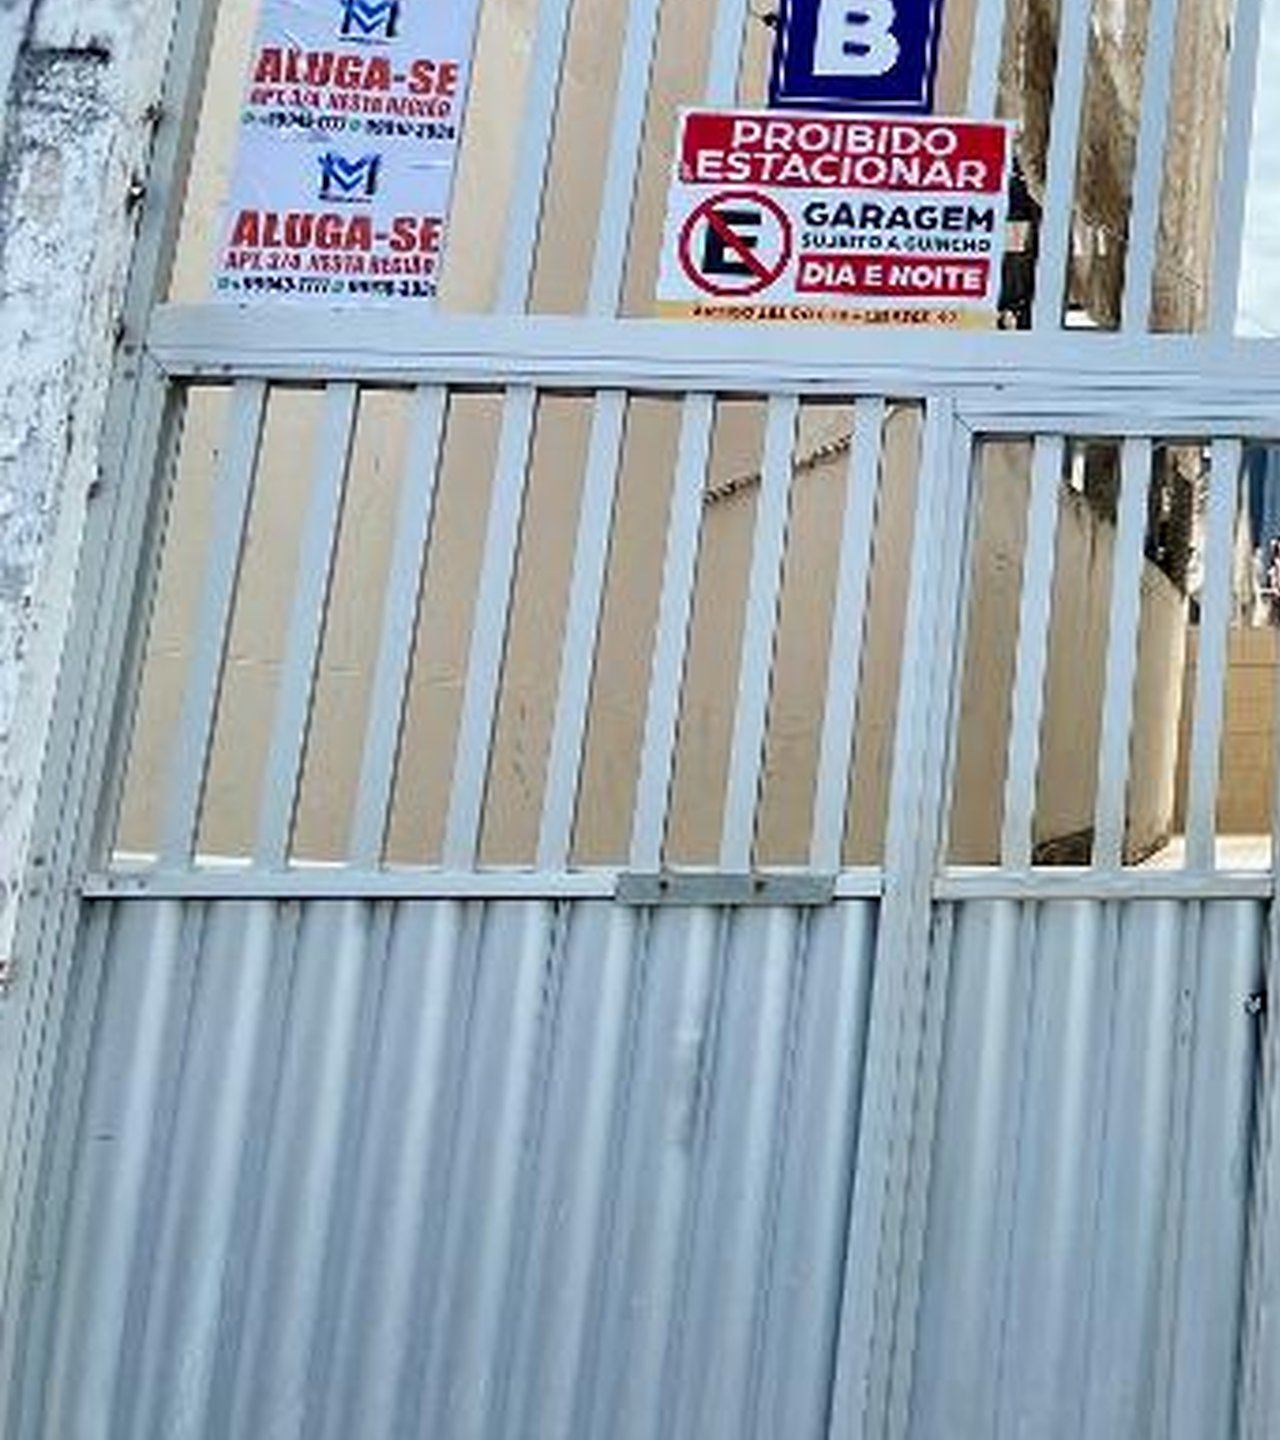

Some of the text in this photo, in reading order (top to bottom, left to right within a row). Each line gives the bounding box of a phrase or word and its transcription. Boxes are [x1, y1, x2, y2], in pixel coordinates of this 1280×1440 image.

[253, 47, 459, 96] ALUGA-SE
[731, 120, 957, 156] PROIBIDO
[697, 150, 987, 189] ESTACIONAR
[229, 209, 443, 253] ALUGA-SE
[803, 201, 994, 233] GARAGEM
[802, 233, 881, 249] SUJEITO
[903, 236, 991, 253] GUINCHO
[802, 261, 983, 290] DIA E NOITE
